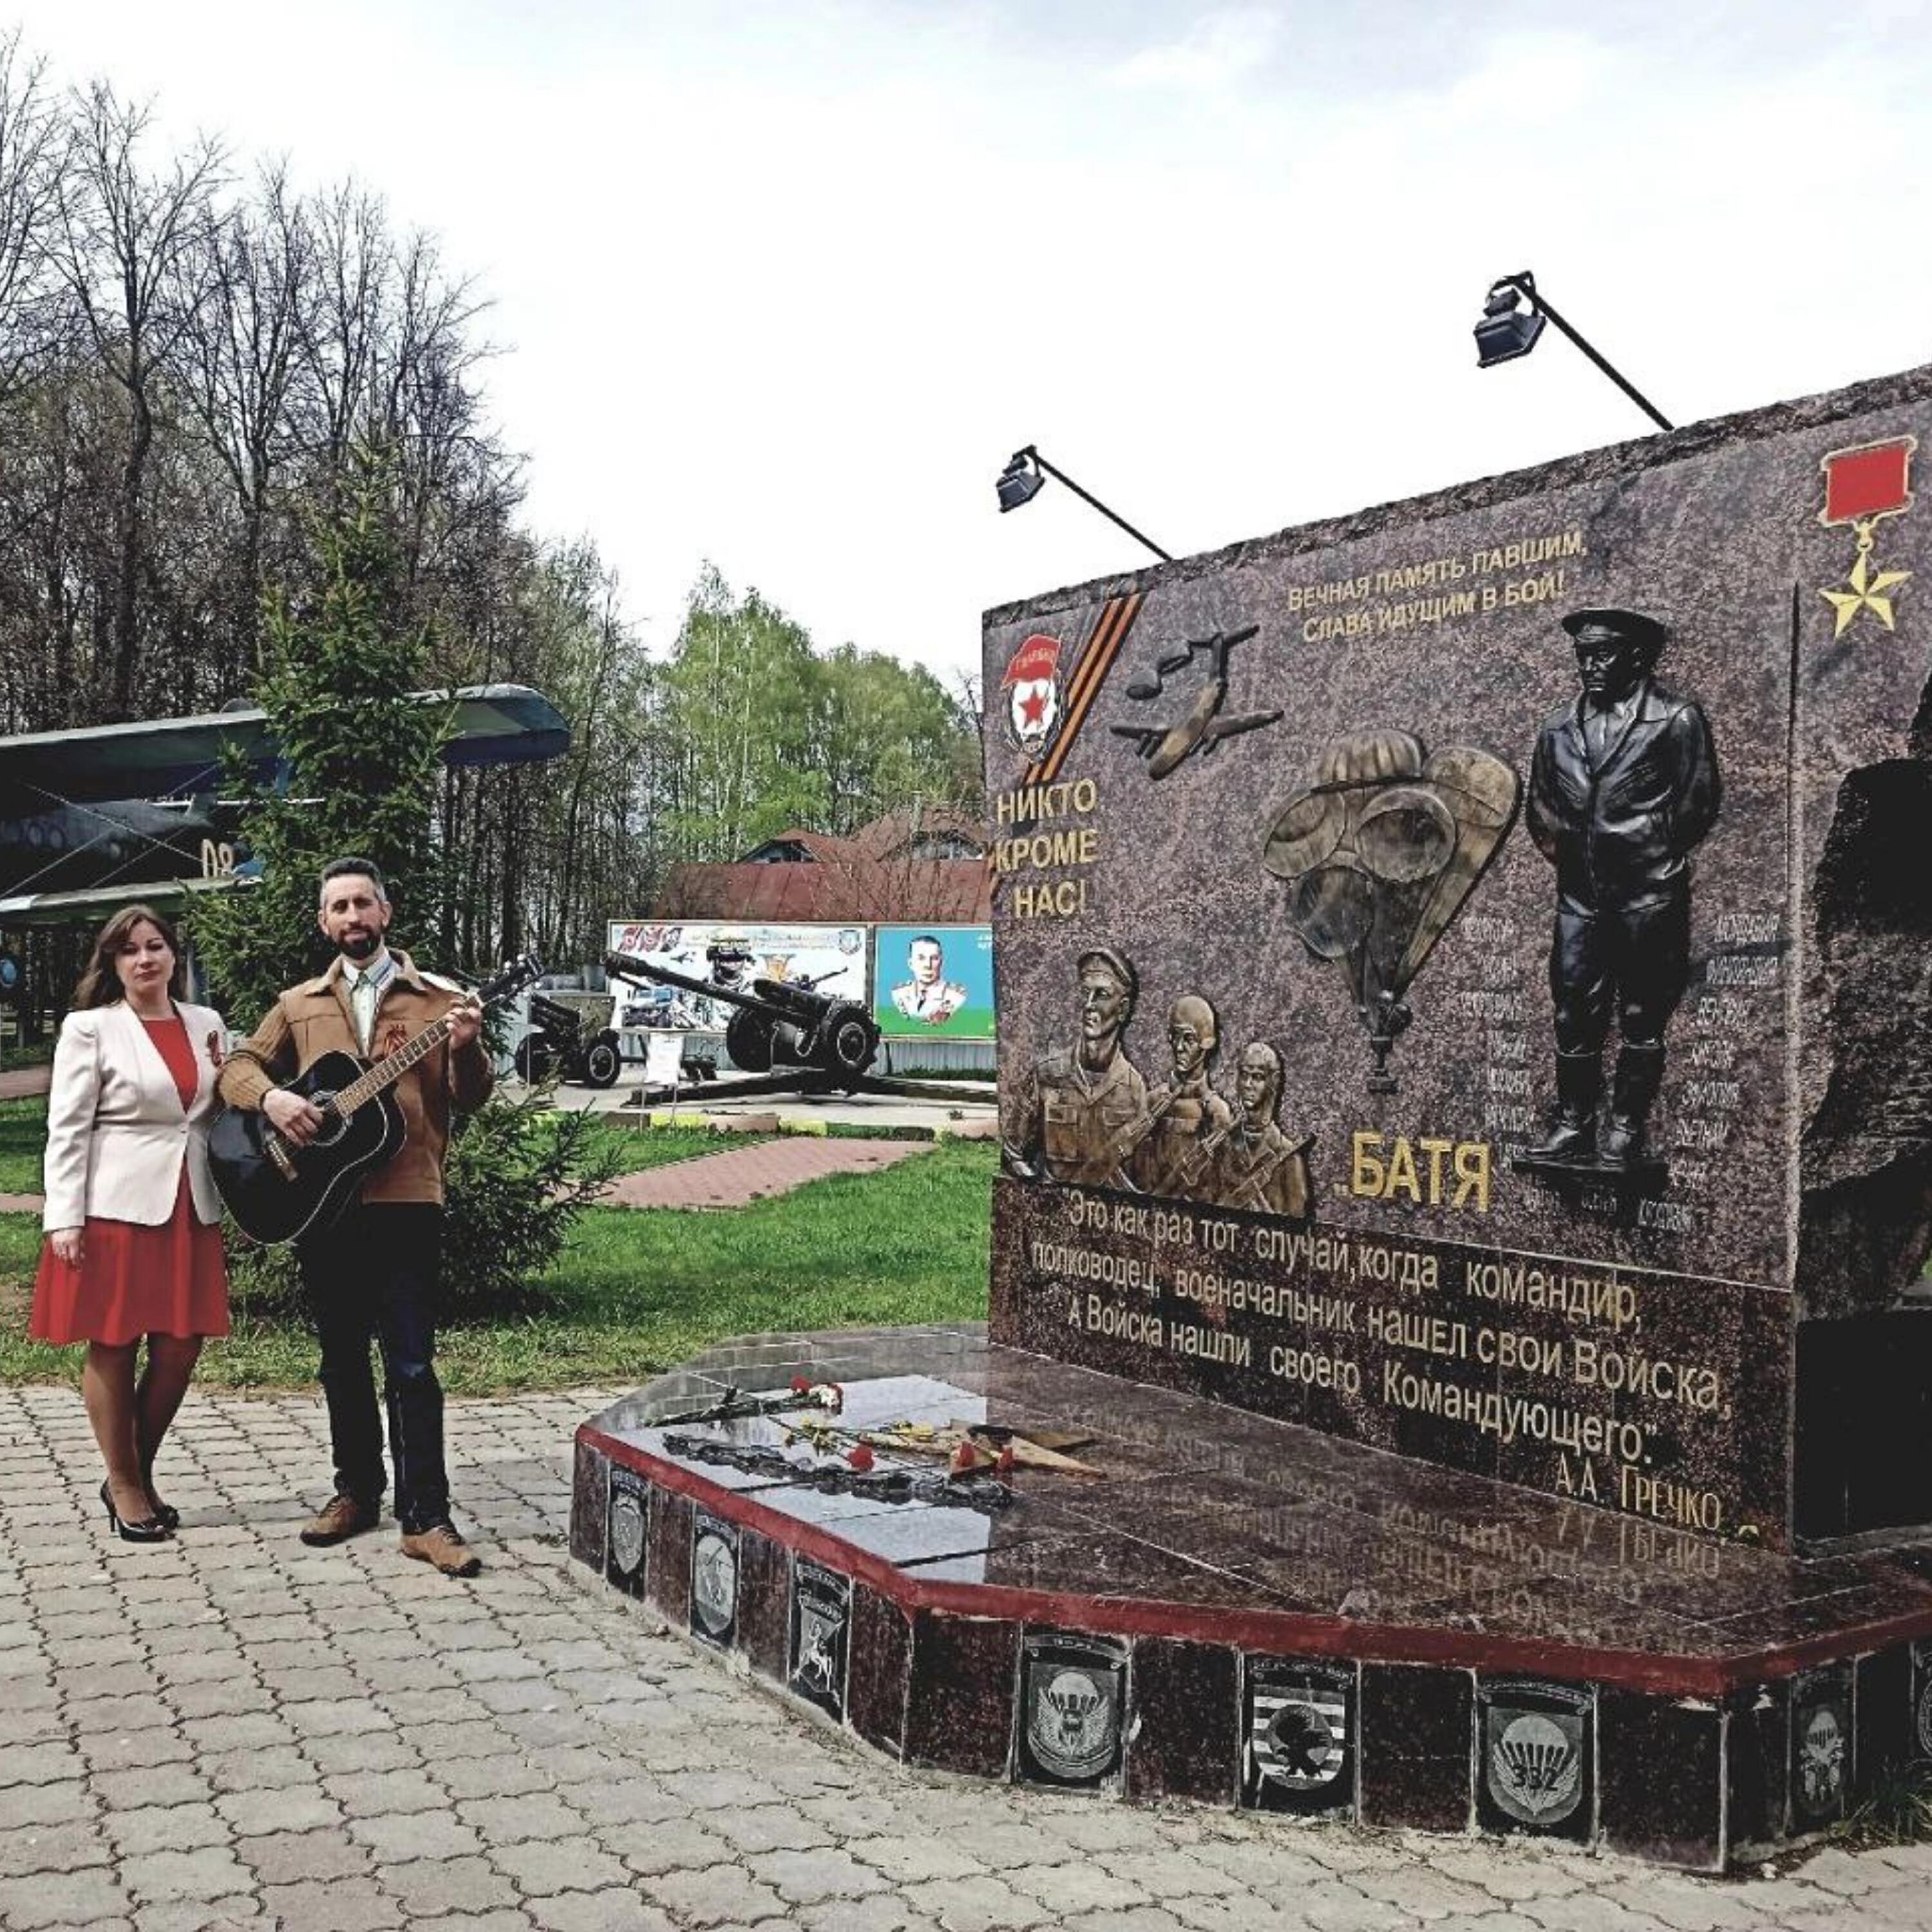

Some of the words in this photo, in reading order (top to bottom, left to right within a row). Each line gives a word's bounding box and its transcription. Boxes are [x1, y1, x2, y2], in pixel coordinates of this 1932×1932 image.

[1289, 576, 1370, 611] ВЕЧНАЯ
[1376, 556, 1465, 593] ПАМЯТЬ
[1472, 531, 1587, 574] ПАВШИМ,
[1303, 611, 1372, 643] СЛАВА
[1378, 592, 1475, 633] ИДУЩИМ
[1482, 587, 1497, 611] В
[1504, 569, 1566, 607] БОЙ!
[998, 778, 1096, 826] НИКТО
[994, 828, 1098, 871] КРОМЕ
[1014, 879, 1086, 918] НАС!
[1114, 1204, 1148, 1238] как
[1154, 1210, 1193, 1248] раз
[1200, 1219, 1240, 1252] тот
[1466, 1261, 1642, 1333] командир,
[1032, 1242, 1160, 1299] полководец,
[1176, 1269, 1356, 1332] военачальник
[1575, 1339, 1732, 1419] Войска,
[1068, 1295, 1082, 1329] А
[1087, 1294, 1162, 1347] Войска
[1170, 1321, 1251, 1367] нашли
[1270, 1346, 1361, 1393] своего
